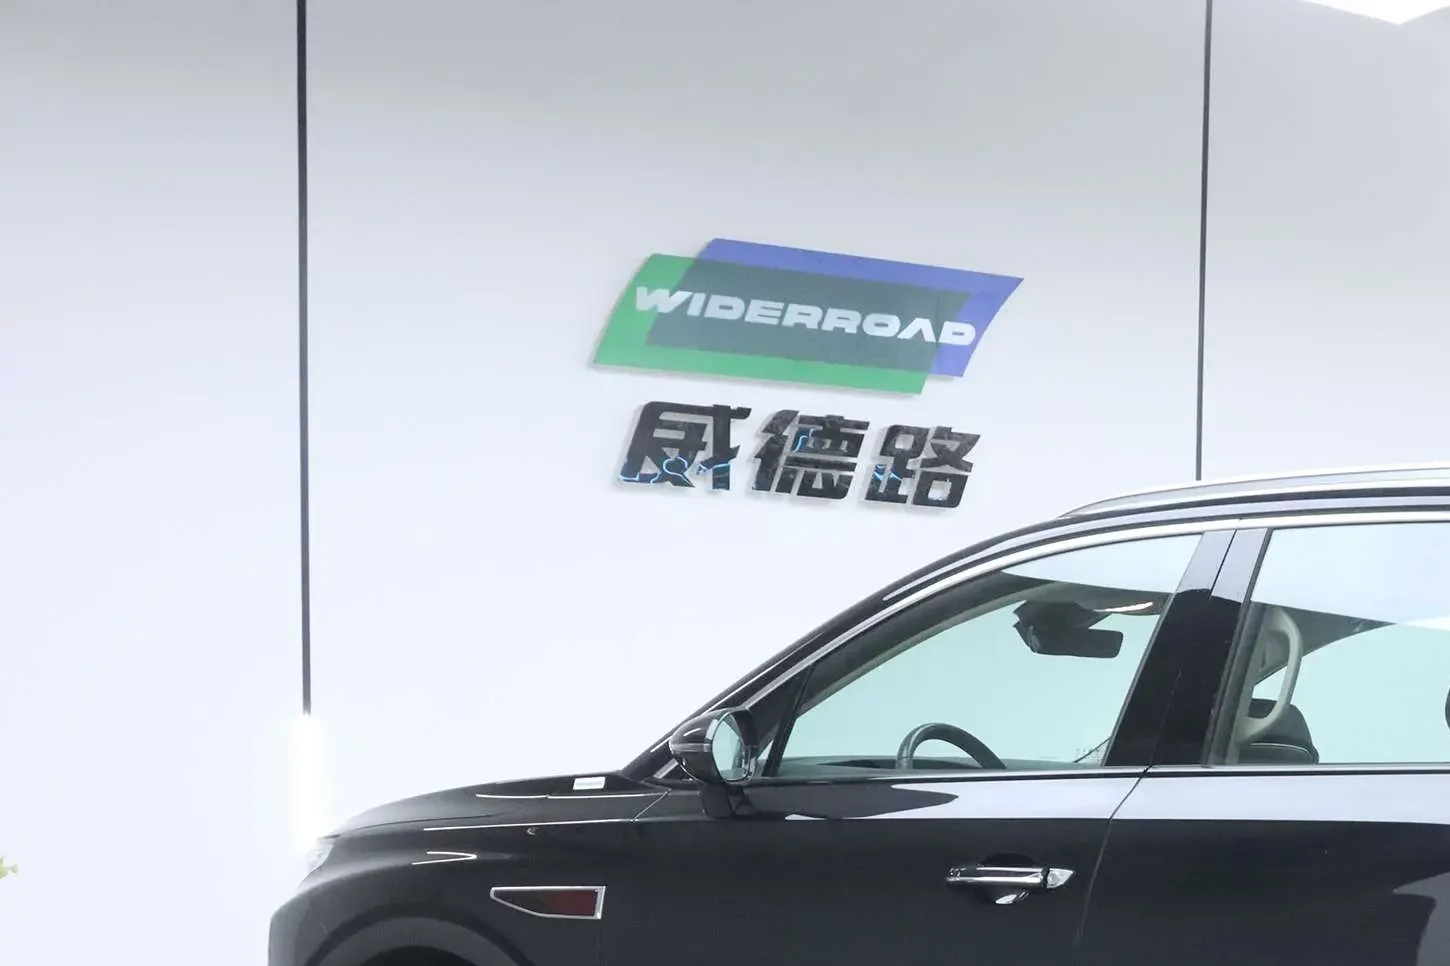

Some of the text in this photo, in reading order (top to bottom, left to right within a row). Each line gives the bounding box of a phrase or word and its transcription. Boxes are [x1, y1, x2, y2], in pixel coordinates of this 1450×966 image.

[635, 286, 976, 346] WIDERROAD
[618, 401, 981, 508] 威德路
